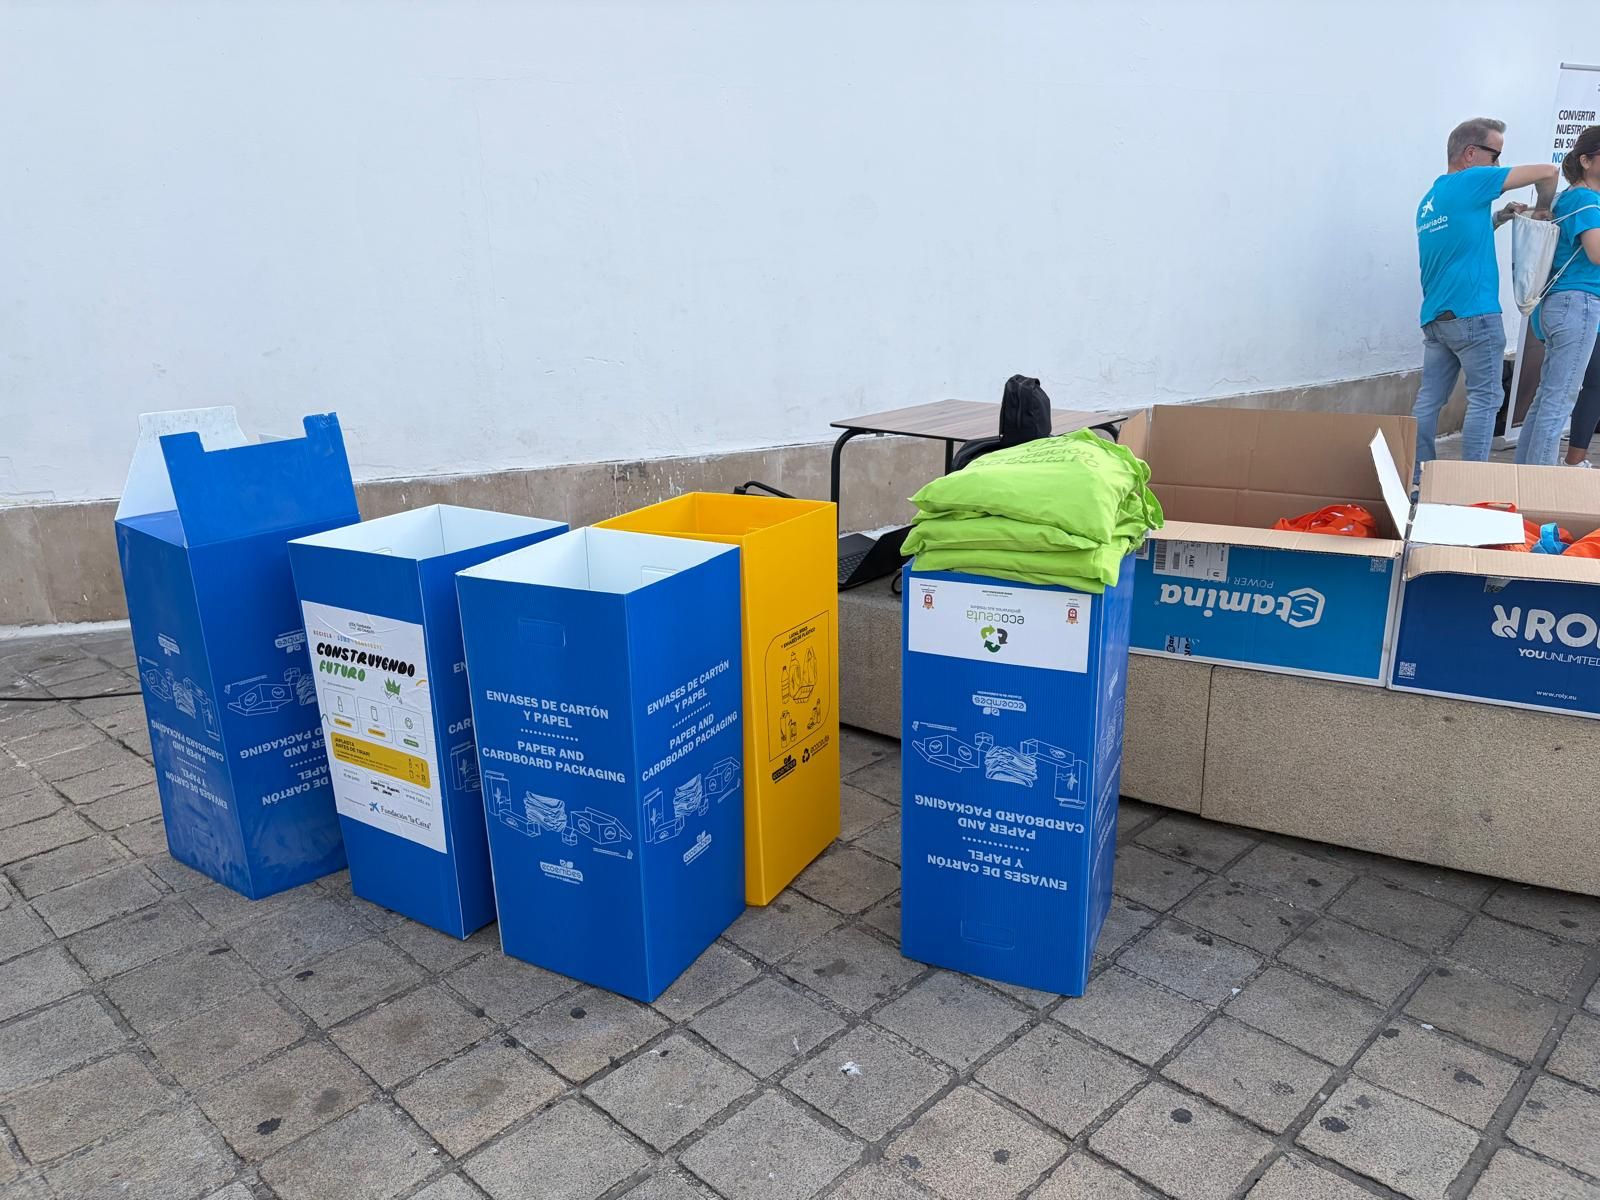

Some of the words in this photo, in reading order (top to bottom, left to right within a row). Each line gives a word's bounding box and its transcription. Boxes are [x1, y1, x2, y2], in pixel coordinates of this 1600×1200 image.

[1559, 110, 1595, 121] CONVERTIR
[1554, 138, 1565, 149] EN
[1233, 576, 1275, 589] POWER
[1160, 583, 1326, 628] Stamina
[966, 609, 1025, 625] ecoceuta
[316, 642, 416, 678] CONSTRUYENDO
[319, 659, 366, 682] FUTURO
[647, 685, 686, 715] ENVASES
[687, 678, 699, 693] DE
[699, 659, 730, 685] CARTÓN
[486, 690, 539, 708] ENVASES
[541, 699, 558, 711] DE
[560, 701, 609, 720] CARTÓN
[674, 702, 681, 713] Y
[681, 687, 708, 710] PAPEL
[974, 696, 1025, 710] ecoembes
[523, 710, 533, 721] Y
[533, 711, 573, 729] PAPEL
[151, 719, 186, 744] PACKAGING
[669, 724, 697, 750] PAPER
[698, 713, 715, 731] AND
[172, 740, 185, 754] AND
[185, 732, 225, 763] CARDBOARD
[186, 745, 207, 764] PAPER
[239, 731, 312, 759] PACKAGING
[283, 743, 310, 758] AND
[517, 740, 556, 756] PAPER
[559, 748, 585, 762] AND
[641, 741, 694, 782] CARDBOARD
[694, 710, 738, 747] PACKAGING
[180, 766, 202, 784] PAPEL
[297, 764, 331, 781] APEL
[482, 747, 552, 770] CARDBOARD
[555, 762, 626, 784] PACKAGING
[190, 781, 199, 794] DE
[202, 777, 207, 788] Y
[313, 776, 329, 789] DE
[199, 786, 228, 810] ENVASES
[261, 783, 311, 806] CARTÓN
[914, 794, 992, 818] PACKAGING
[957, 817, 986, 830] AND
[995, 809, 1085, 834] CARDBOARD
[990, 823, 1036, 840] PAPER
[927, 854, 980, 873] CARTÓN
[968, 849, 1011, 867] PAPEL
[1014, 859, 1024, 868] Y
[541, 863, 582, 879] ecoembes
[982, 865, 1000, 877] DE
[1003, 869, 1068, 891] ENVASES
